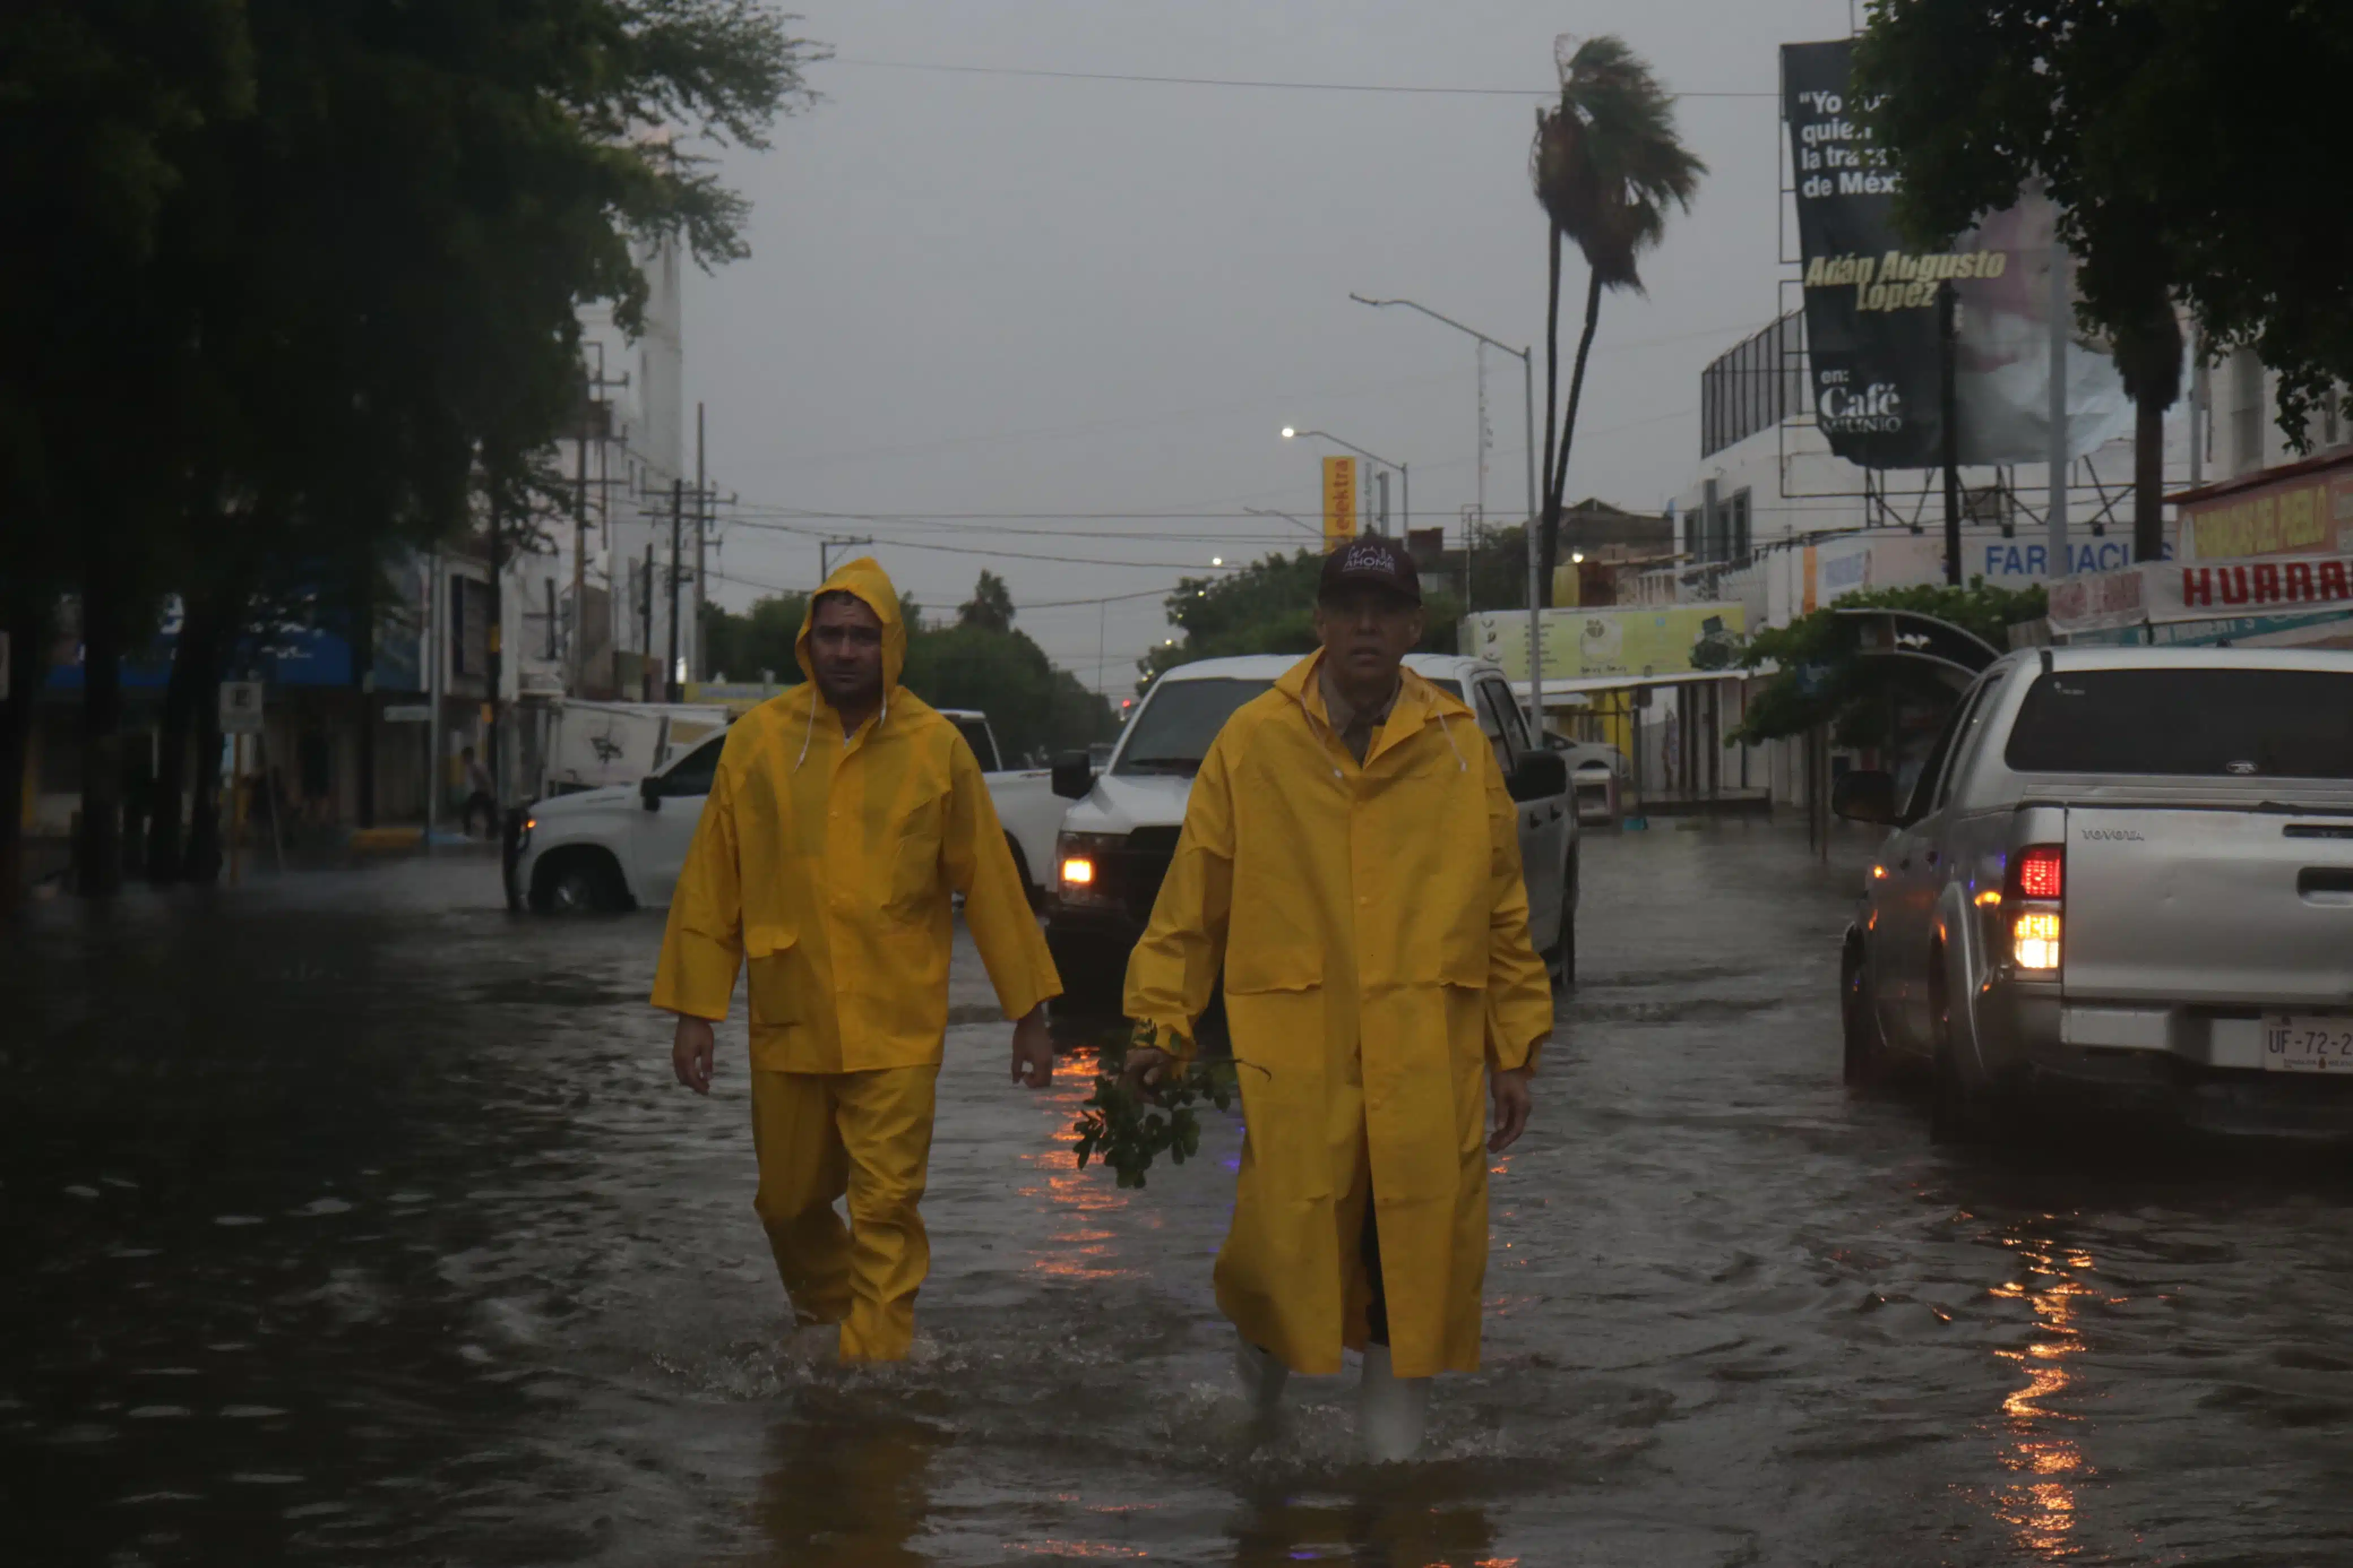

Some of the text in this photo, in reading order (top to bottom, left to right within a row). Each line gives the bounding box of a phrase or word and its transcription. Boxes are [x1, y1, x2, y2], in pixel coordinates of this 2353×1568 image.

[1801, 148, 1822, 171] la
[1802, 174, 1833, 198] de
[1805, 250, 2006, 286] Adán Augusto
[1820, 369, 1850, 385] en:
[1820, 382, 1901, 420] Café
[1333, 460, 1349, 530] elektra
[2183, 561, 2353, 607] HUARA
